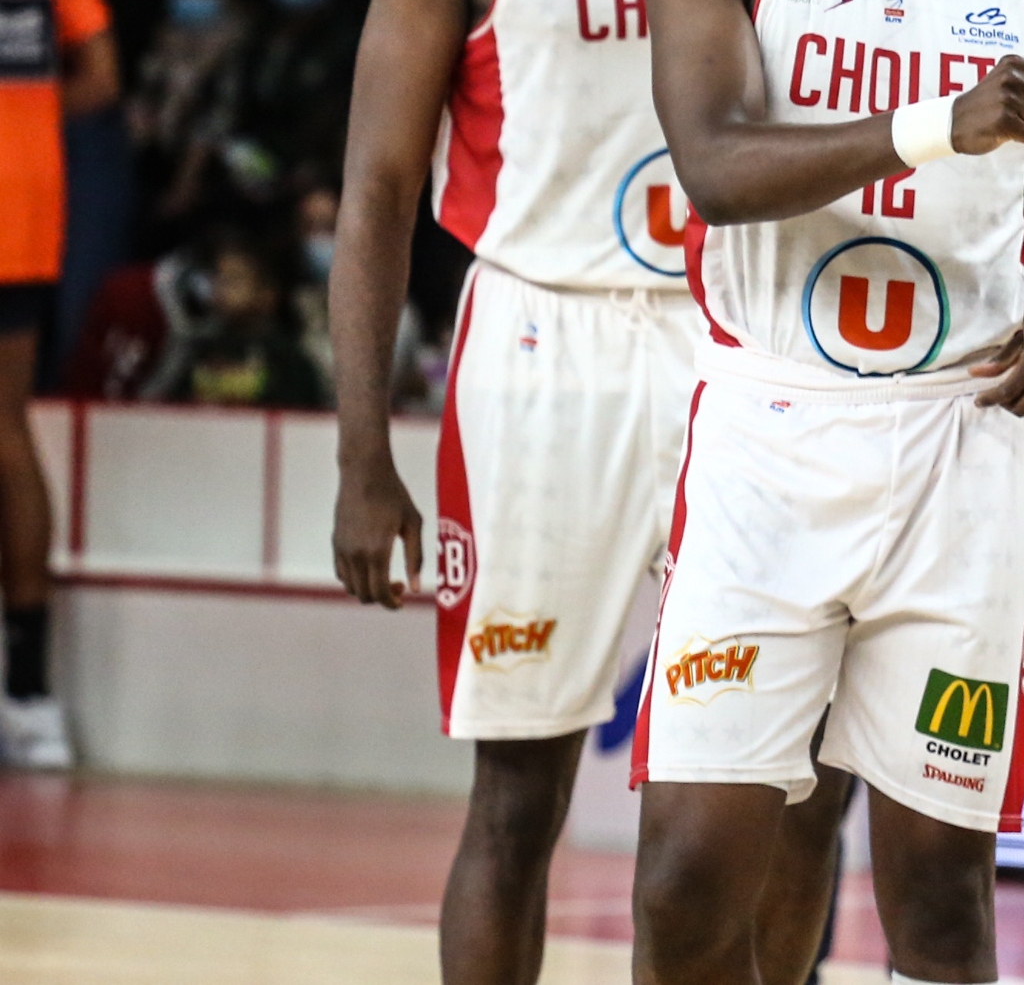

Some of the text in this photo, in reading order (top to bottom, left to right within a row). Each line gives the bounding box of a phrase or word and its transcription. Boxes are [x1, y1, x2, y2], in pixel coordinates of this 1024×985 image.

[951, 25, 966, 36] Le
[838, 275, 915, 351] U
[469, 617, 558, 665] PITCH
[665, 644, 759, 696] PITCH
[926, 741, 992, 767] CHOLET
[922, 763, 986, 793] SPALDING
